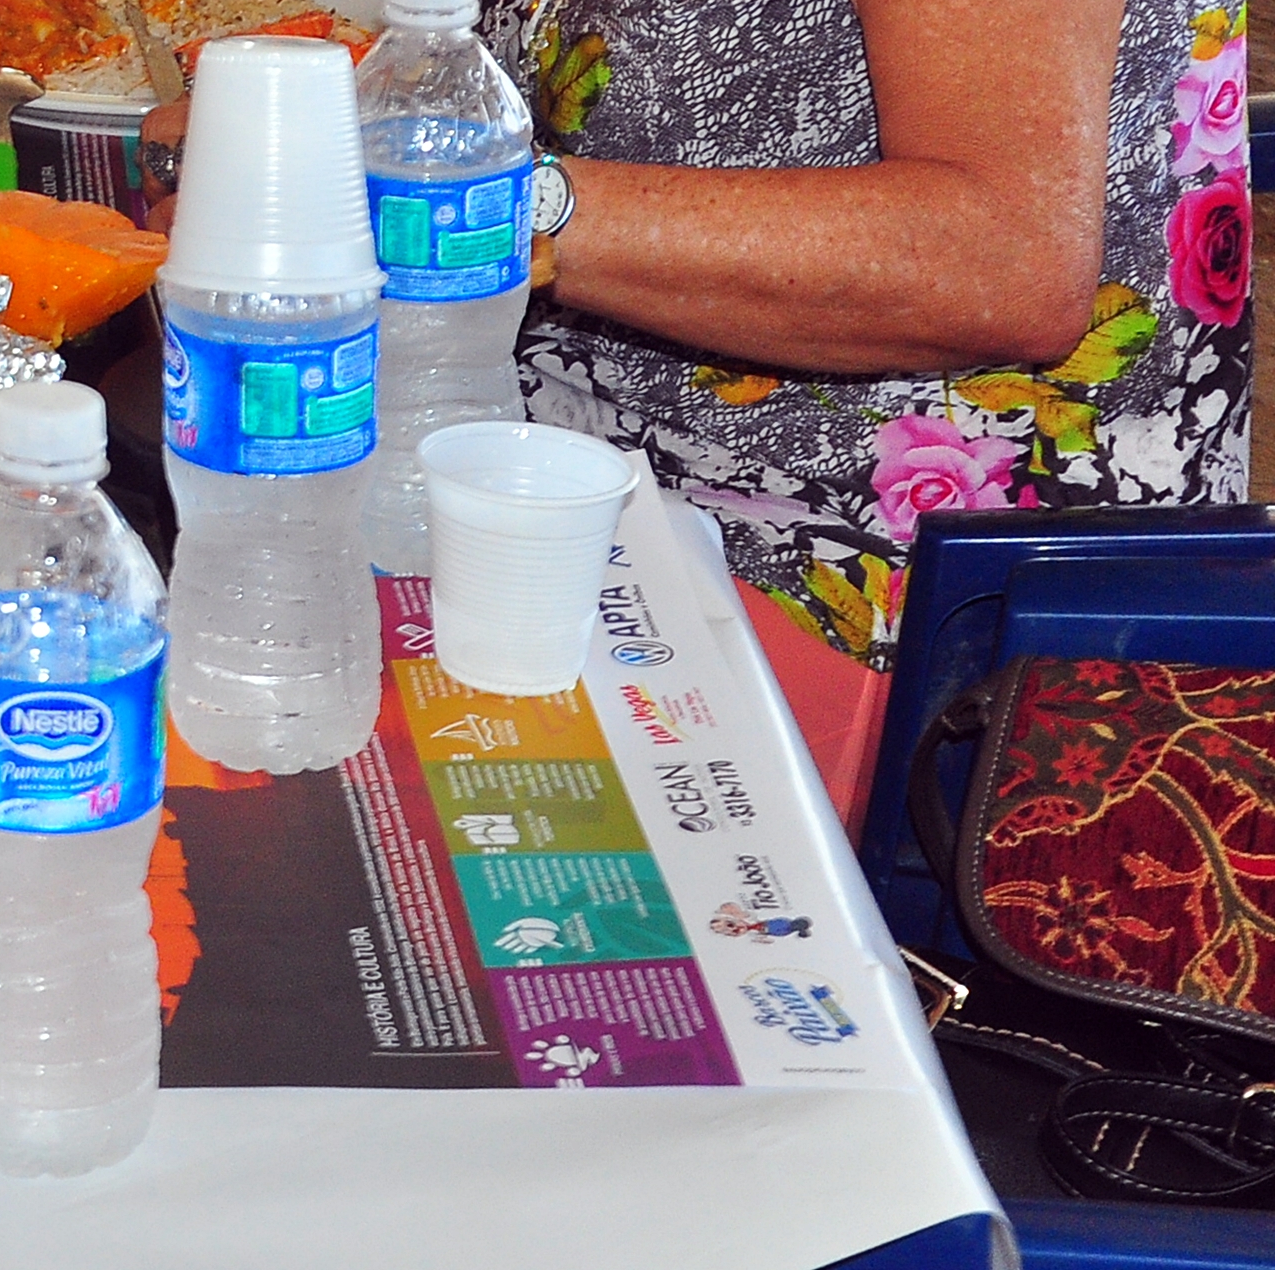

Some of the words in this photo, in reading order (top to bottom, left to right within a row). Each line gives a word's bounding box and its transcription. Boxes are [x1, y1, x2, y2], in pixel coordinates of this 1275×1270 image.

[598, 584, 645, 638] APTA
[9, 706, 101, 734] Nestlé
[619, 684, 657, 723] Vegas
[645, 723, 684, 745] Las
[1, 760, 66, 784] Pureza
[707, 759, 757, 819] 3316-7170
[349, 925, 383, 981] CULTURA
[361, 981, 386, 992] E
[365, 991, 401, 1047] HISTÓRIA
